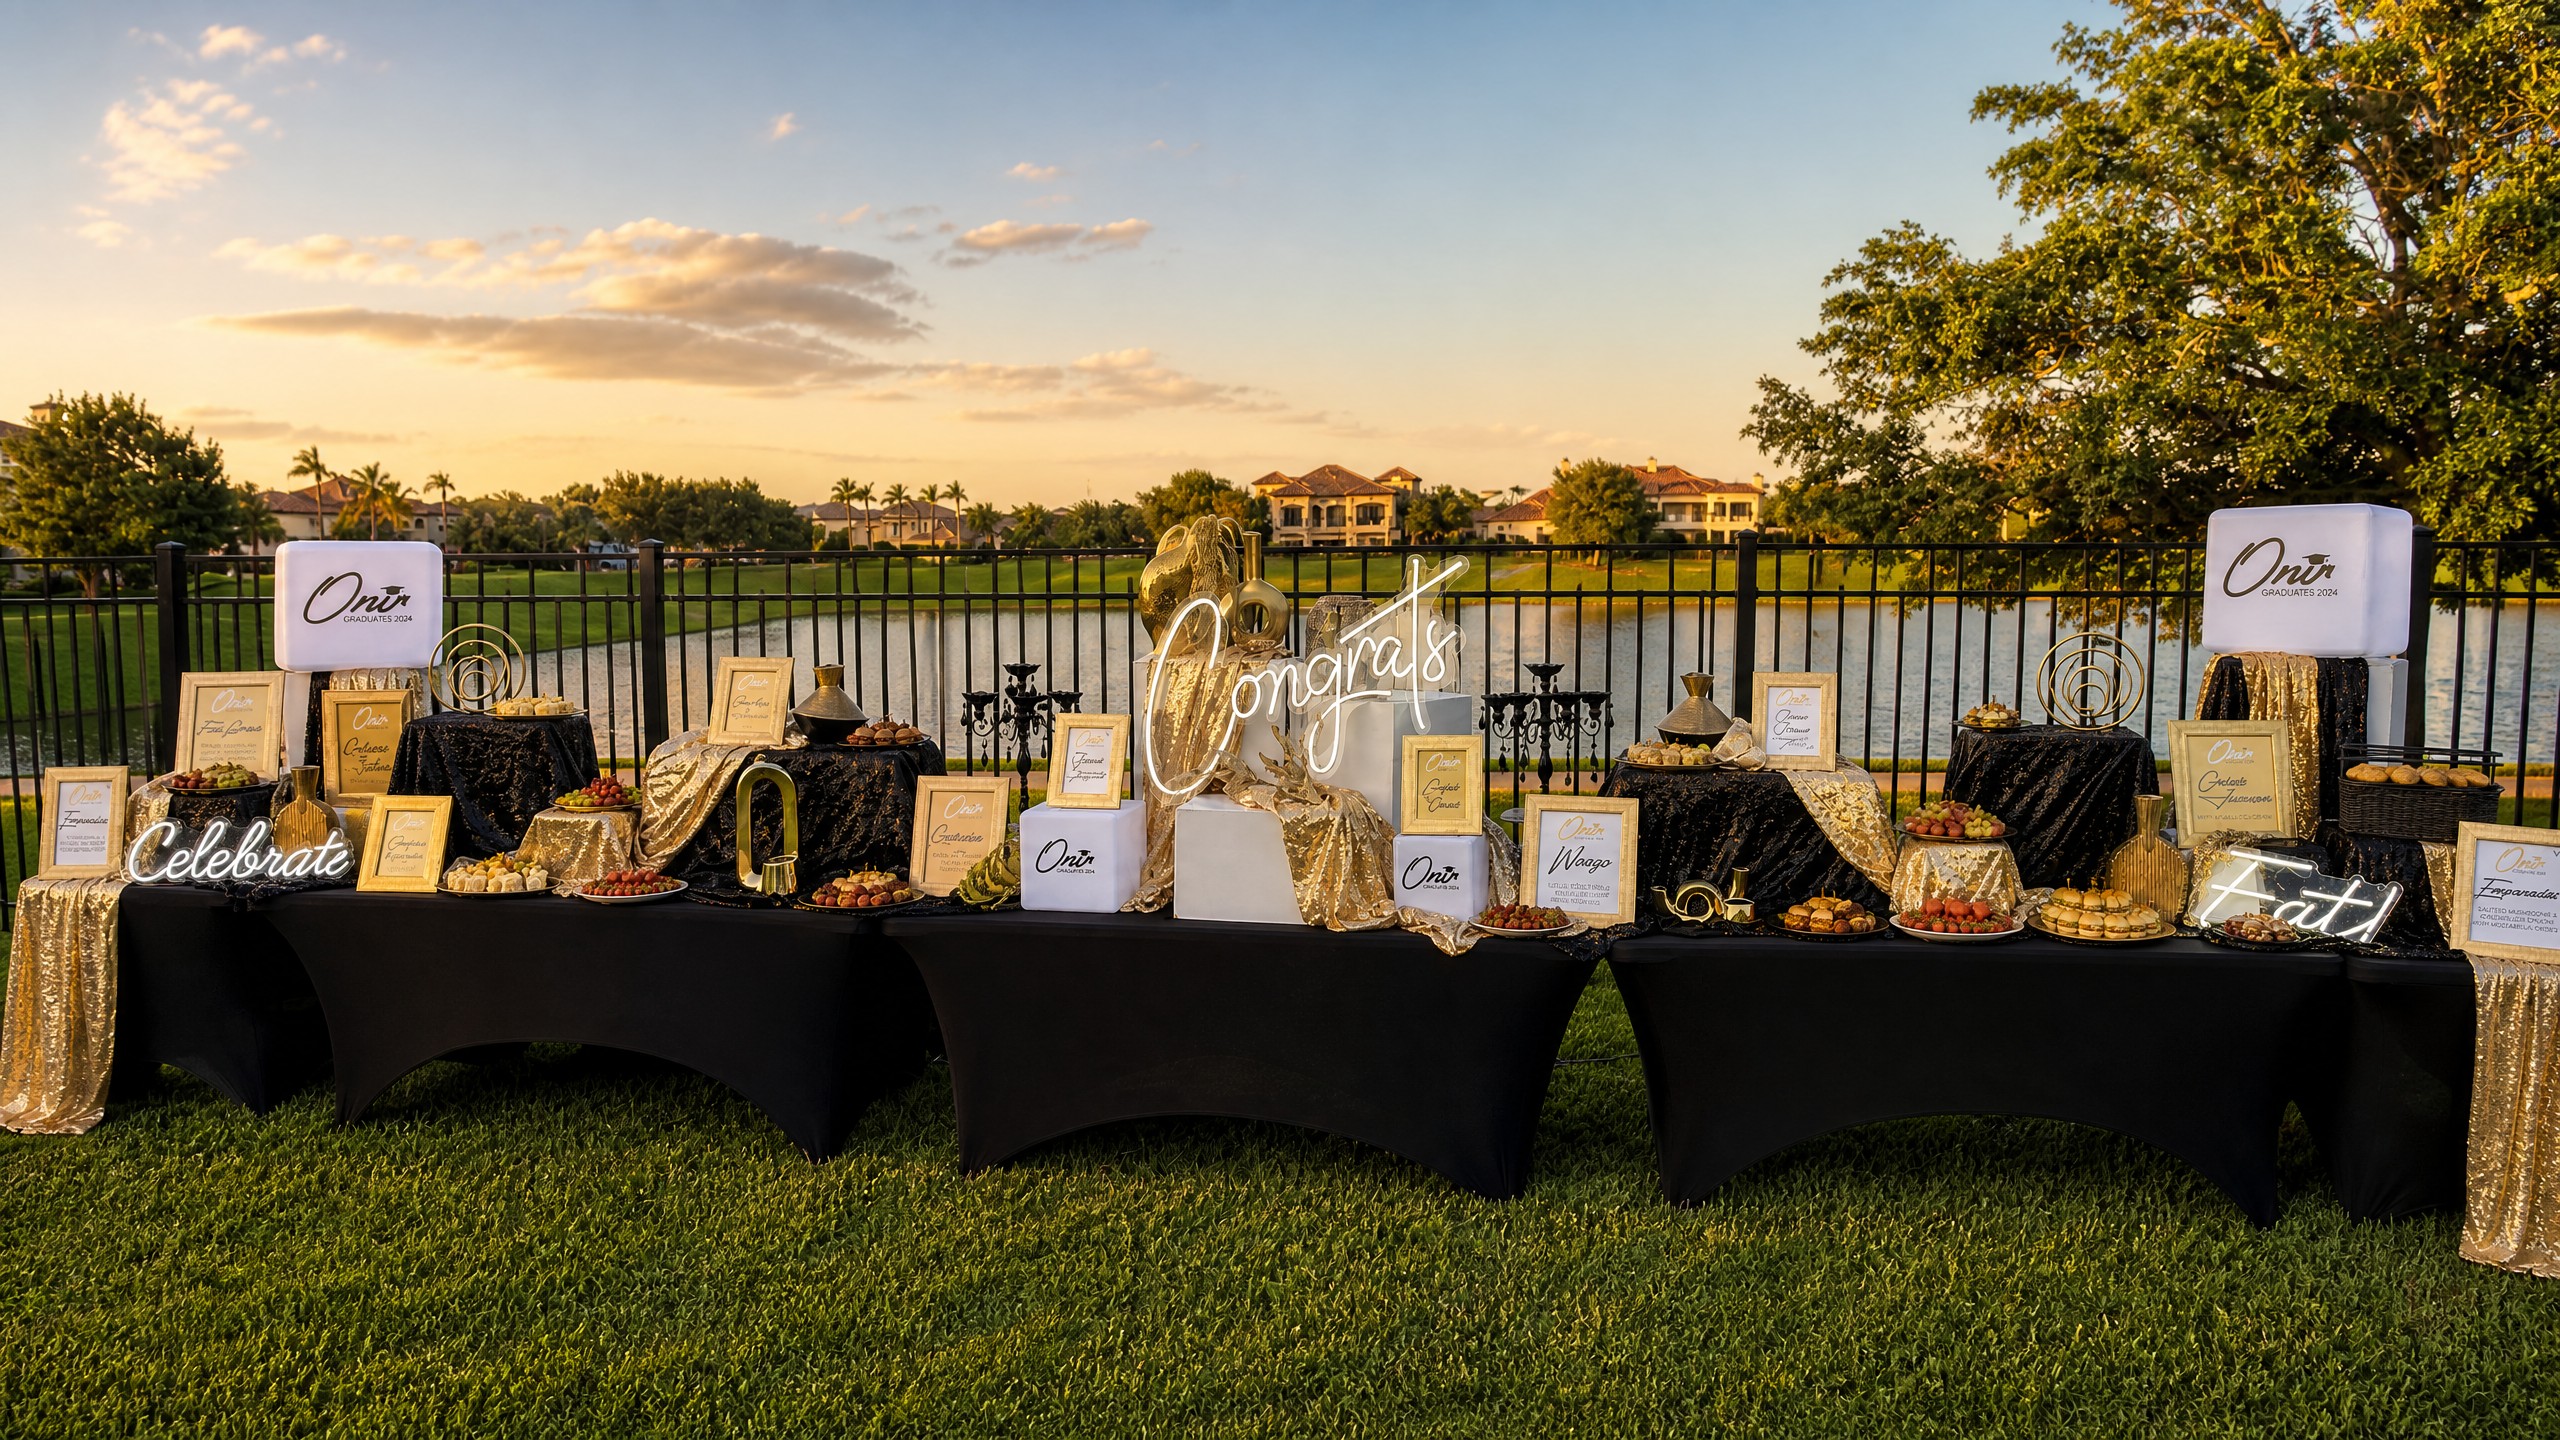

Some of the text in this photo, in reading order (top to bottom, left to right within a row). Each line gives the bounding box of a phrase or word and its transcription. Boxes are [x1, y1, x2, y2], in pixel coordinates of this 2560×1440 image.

[2261, 588, 2338, 597] GRADUATES 2024
[343, 615, 413, 623] GRADUATES 2024
[1146, 558, 1464, 795] Congrats
[129, 820, 349, 882] Celebrate
